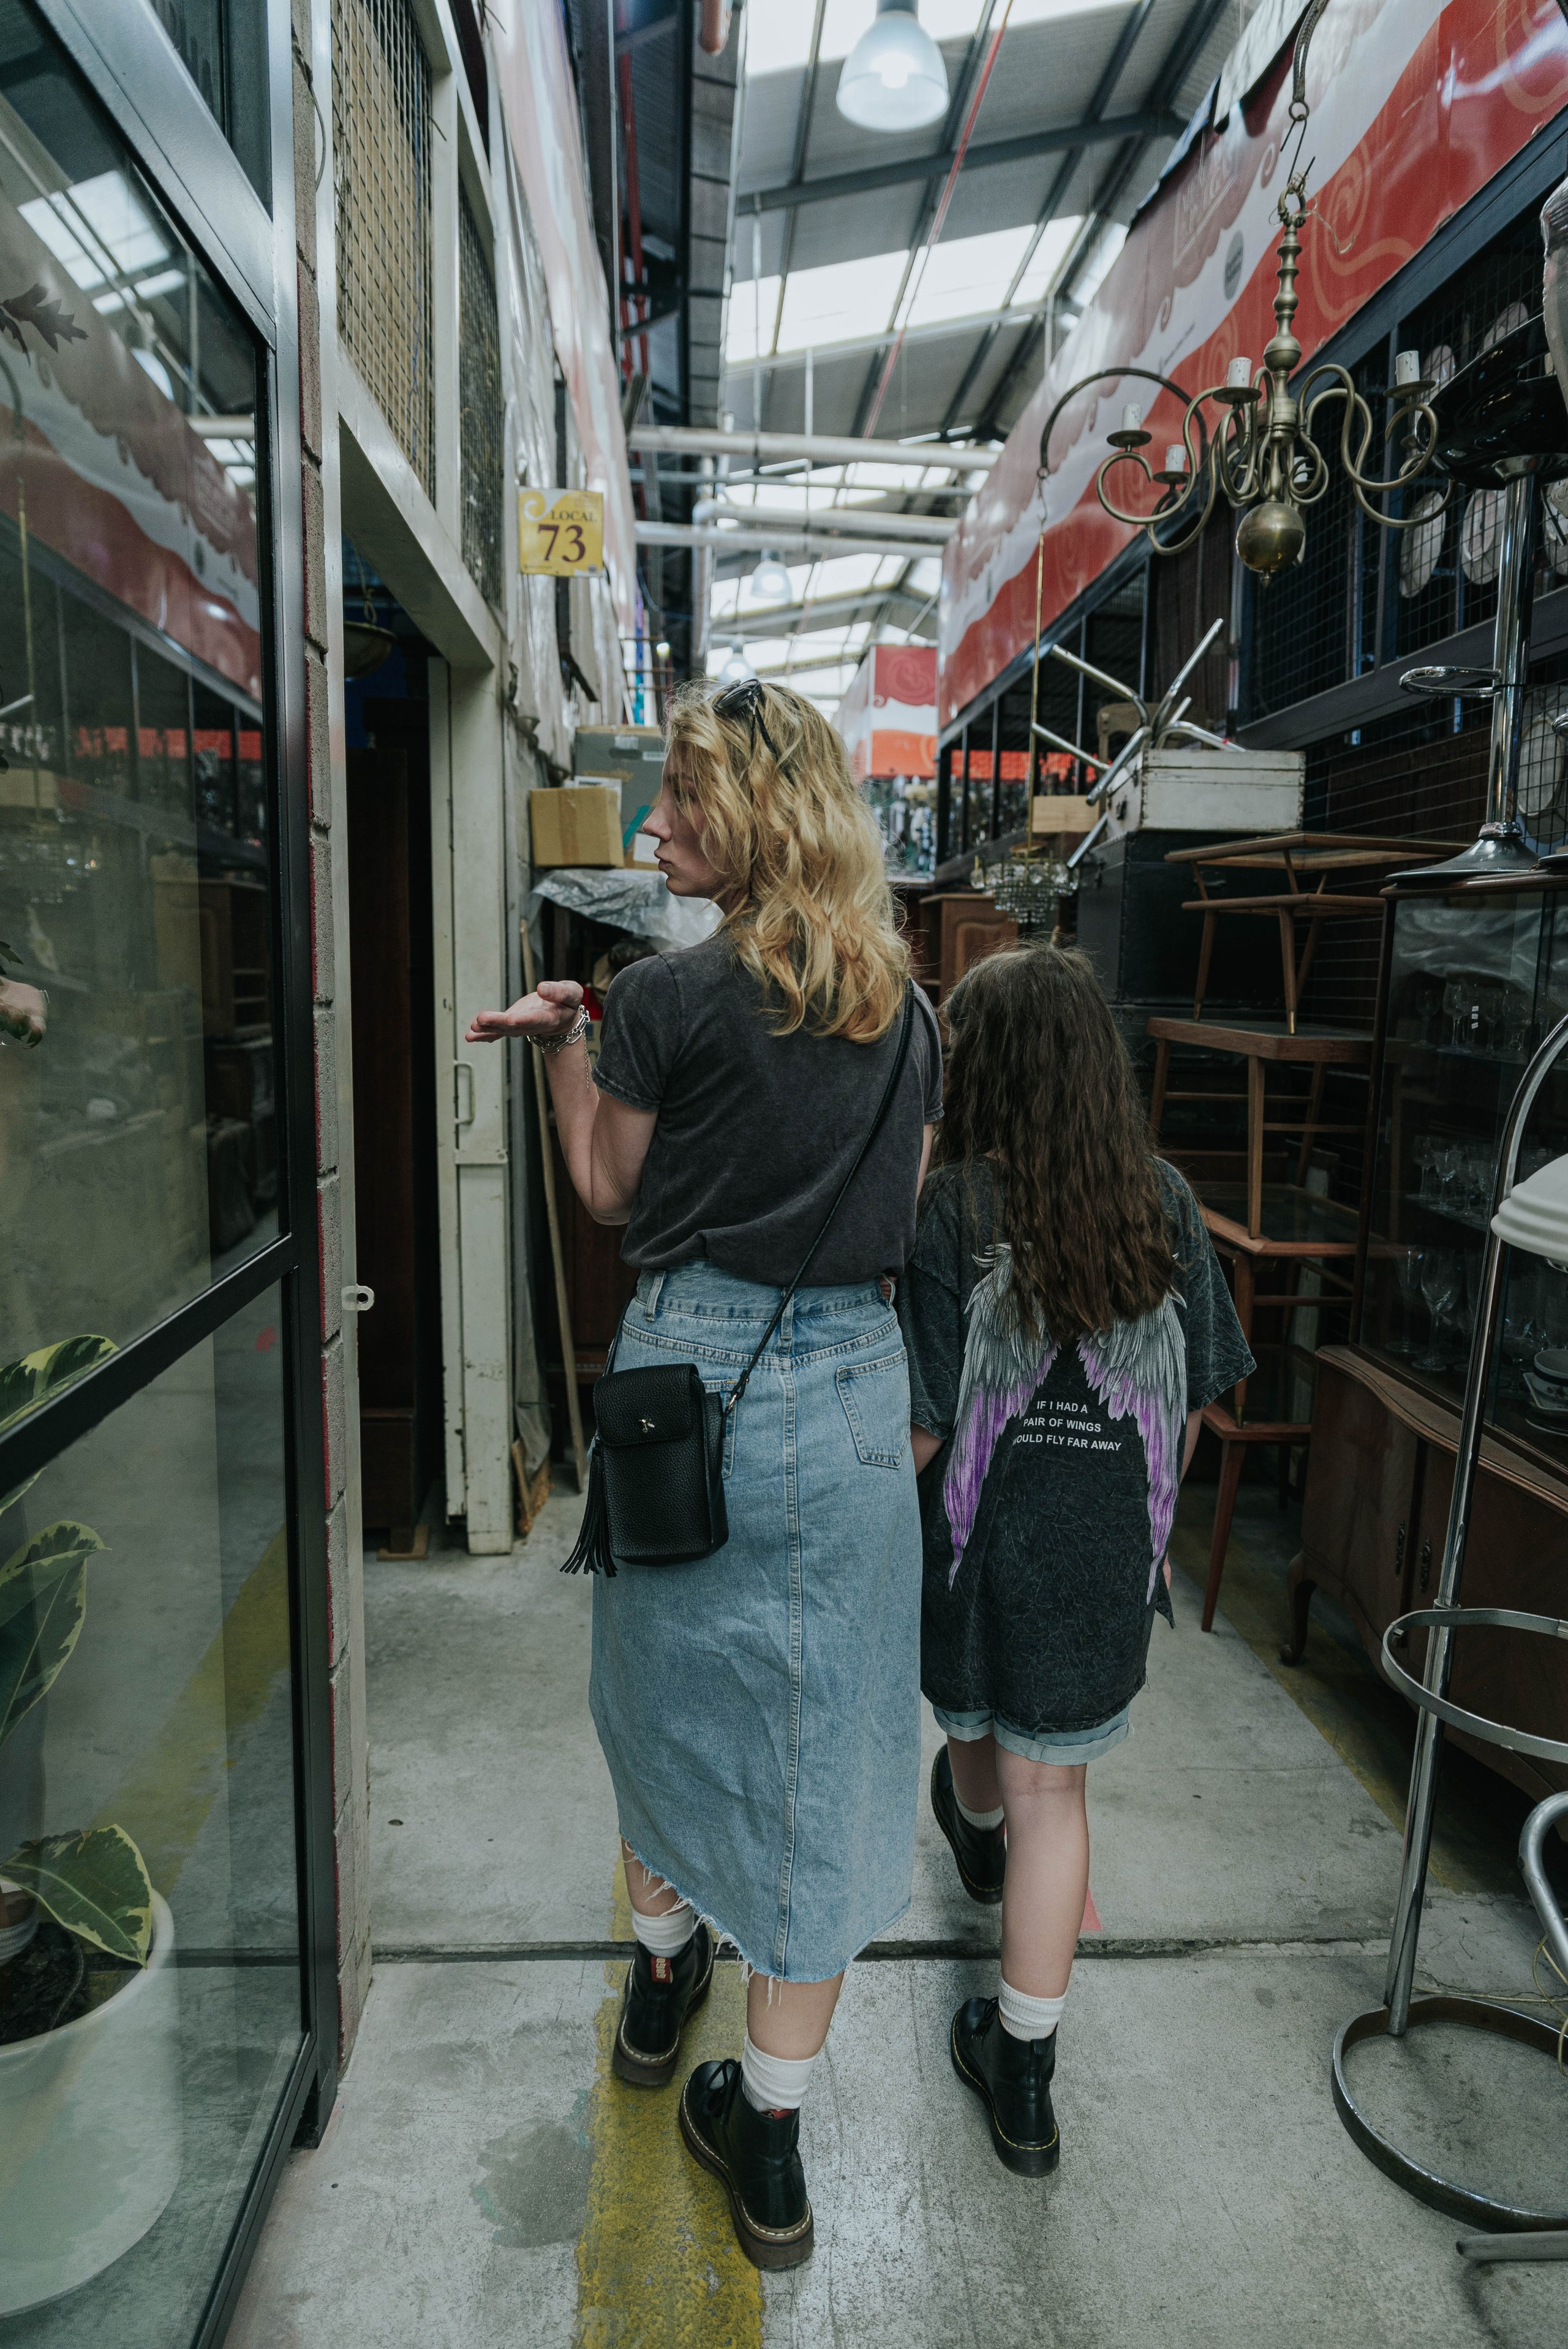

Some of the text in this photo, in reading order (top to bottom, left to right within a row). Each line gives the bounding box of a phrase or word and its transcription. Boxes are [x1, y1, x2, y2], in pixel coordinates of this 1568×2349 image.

[551, 510, 598, 522] LOCAL
[538, 524, 586, 562] 73
[1036, 1401, 1088, 1414] IF I HAD A
[1023, 1417, 1101, 1433] PAIR OF WINGS
[1046, 1435, 1065, 1446] FLY
[1067, 1437, 1088, 1449] FAR
[1090, 1440, 1122, 1451] AWAY
